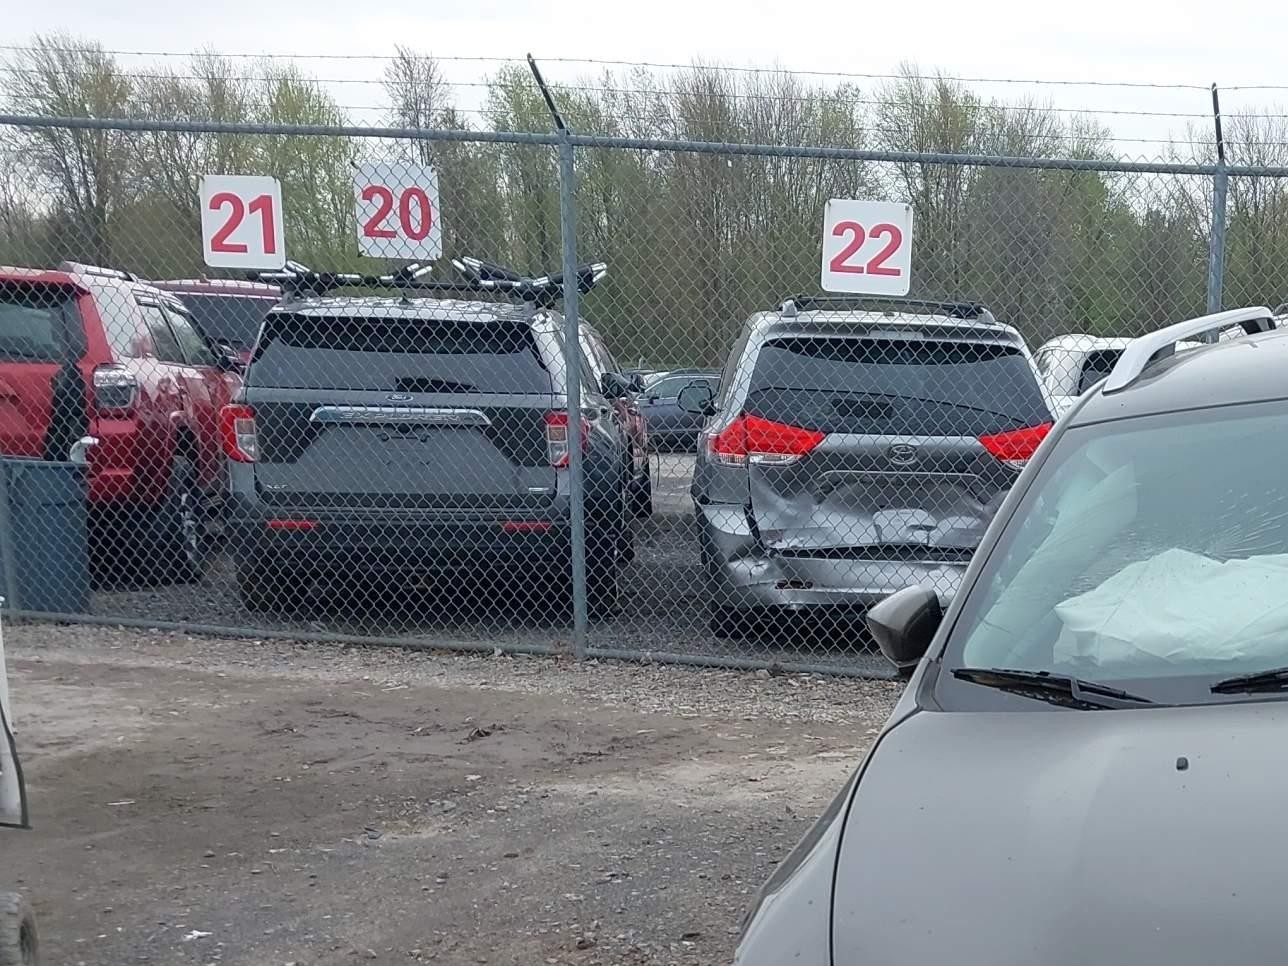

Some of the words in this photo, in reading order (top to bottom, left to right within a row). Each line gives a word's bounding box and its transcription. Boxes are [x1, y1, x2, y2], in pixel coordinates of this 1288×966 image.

[210, 192, 276, 253] 21
[361, 186, 432, 242] 20
[830, 221, 902, 277] 22
